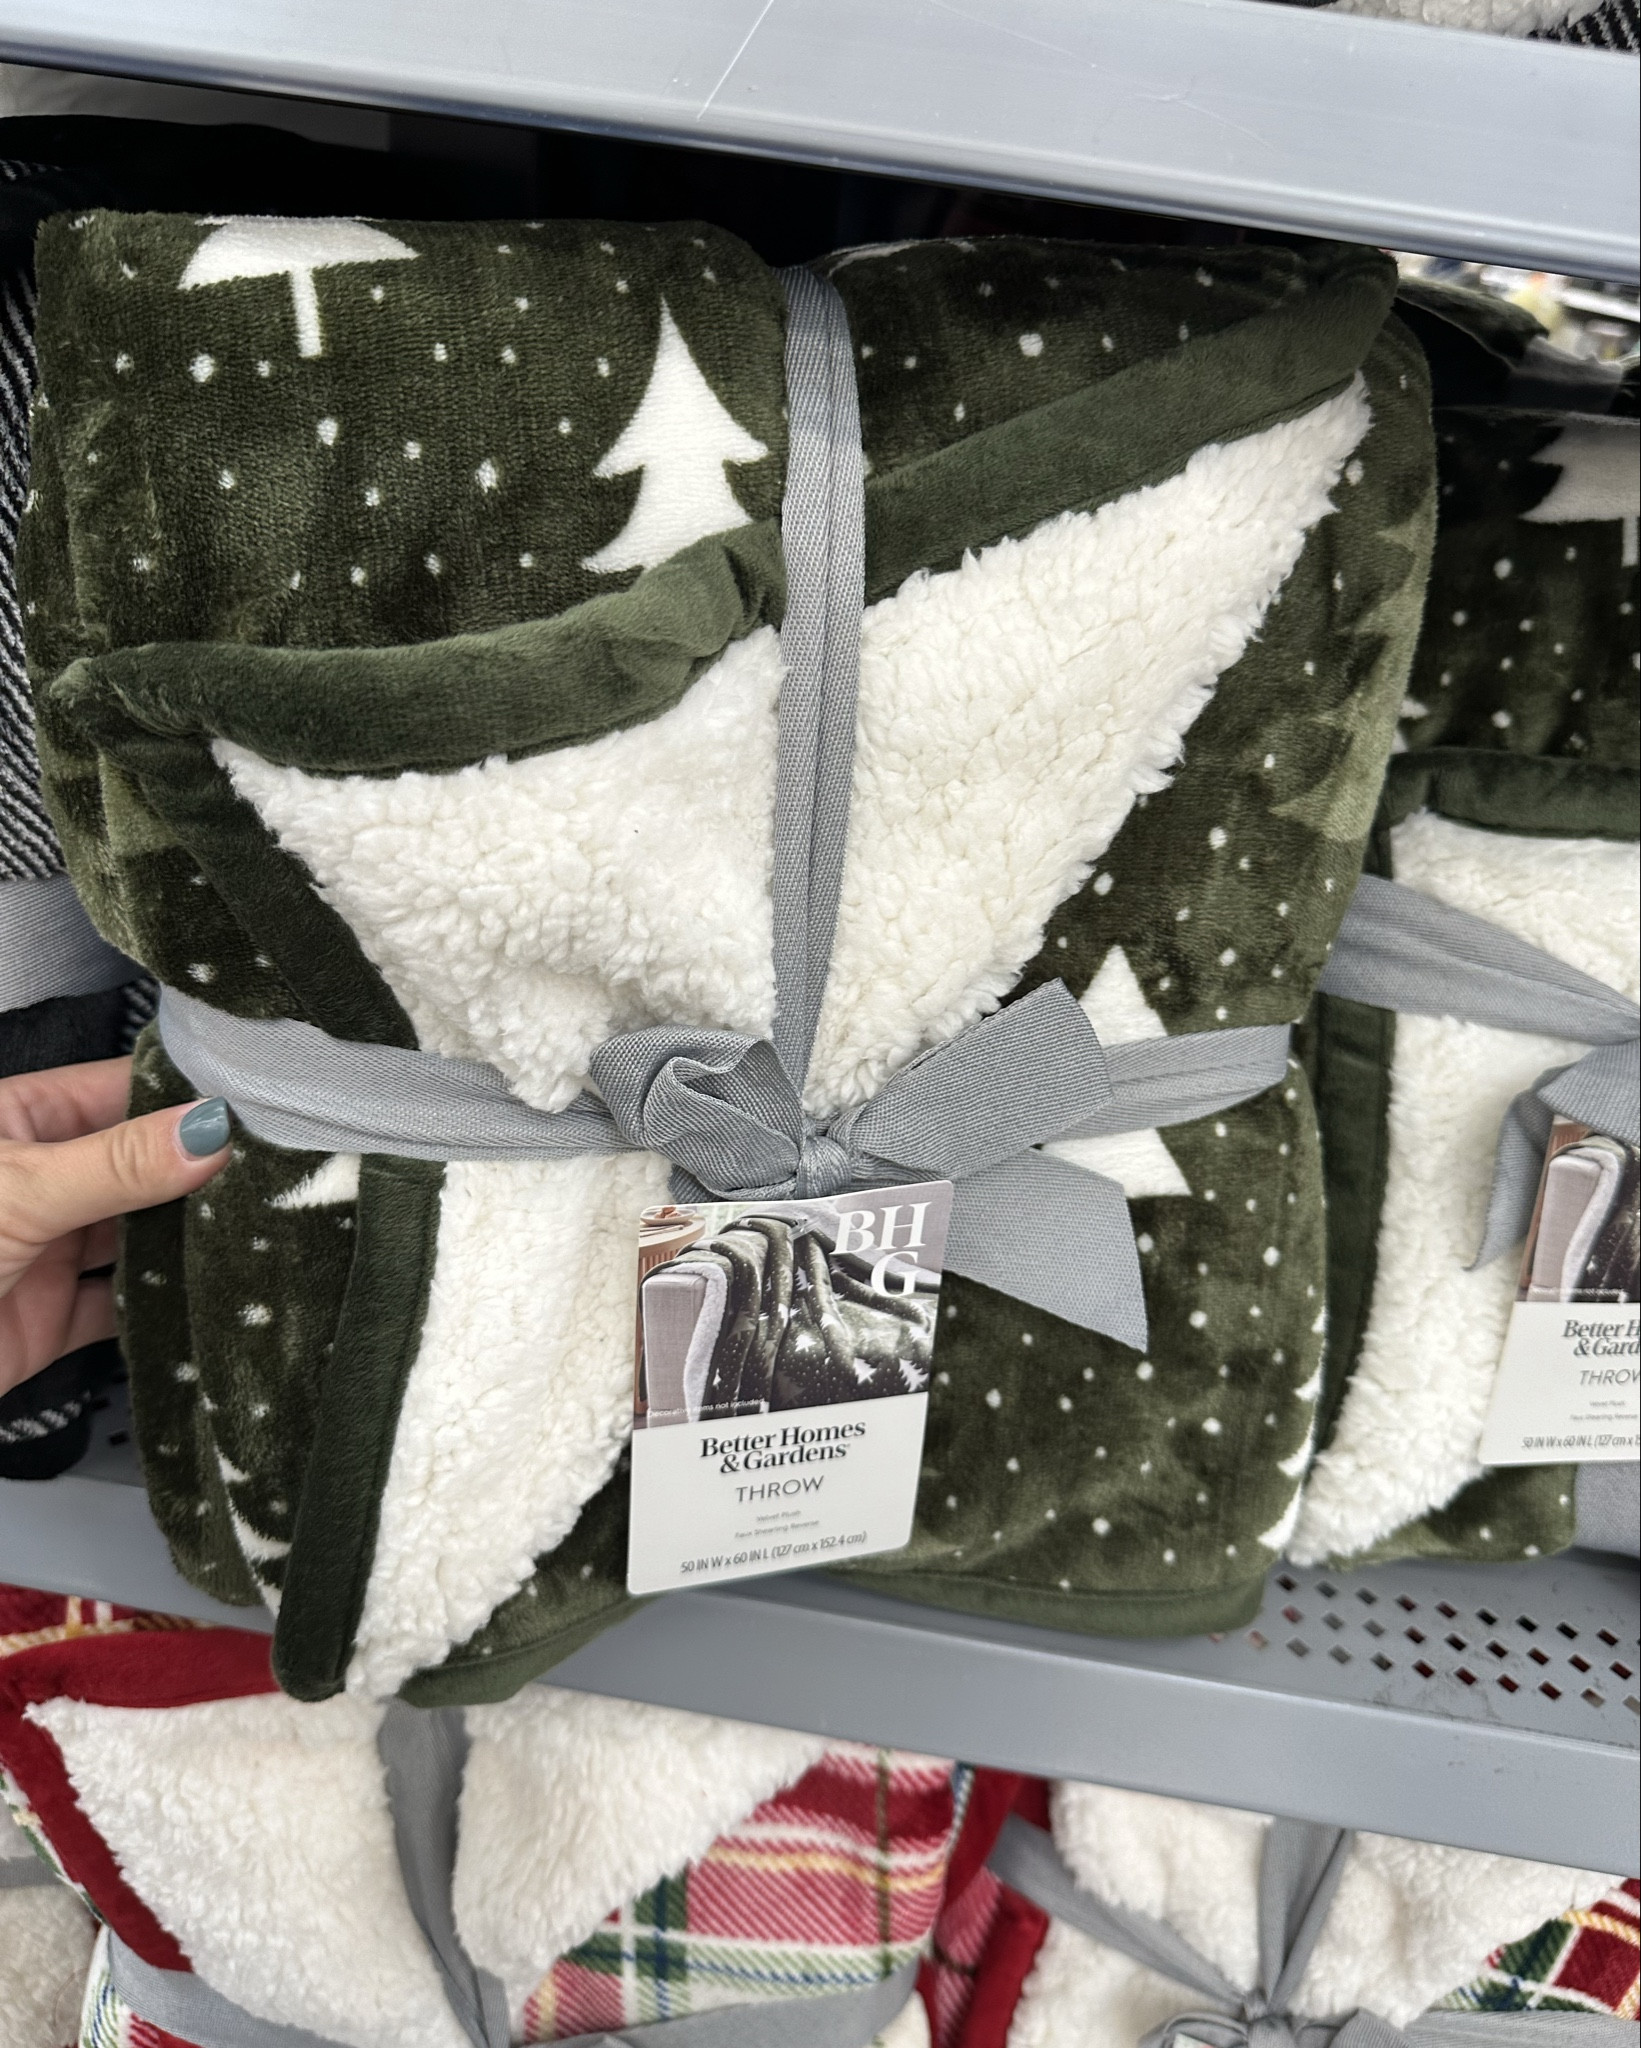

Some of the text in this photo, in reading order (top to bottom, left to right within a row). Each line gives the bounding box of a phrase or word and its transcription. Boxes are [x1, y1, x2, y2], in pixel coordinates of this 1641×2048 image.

[828, 1201, 932, 1255] BH
[871, 1250, 920, 1298] G
[1561, 1319, 1625, 1338] Better
[1573, 1336, 1640, 1356] & Gard
[715, 1401, 729, 1410] not
[700, 1421, 866, 1458] Better Homes
[719, 1443, 847, 1474] & Gardens
[736, 1475, 824, 1503] THROW
[680, 1530, 867, 1573] 50 IN W x 60 IN L (127 cm x 152.4 cm)
